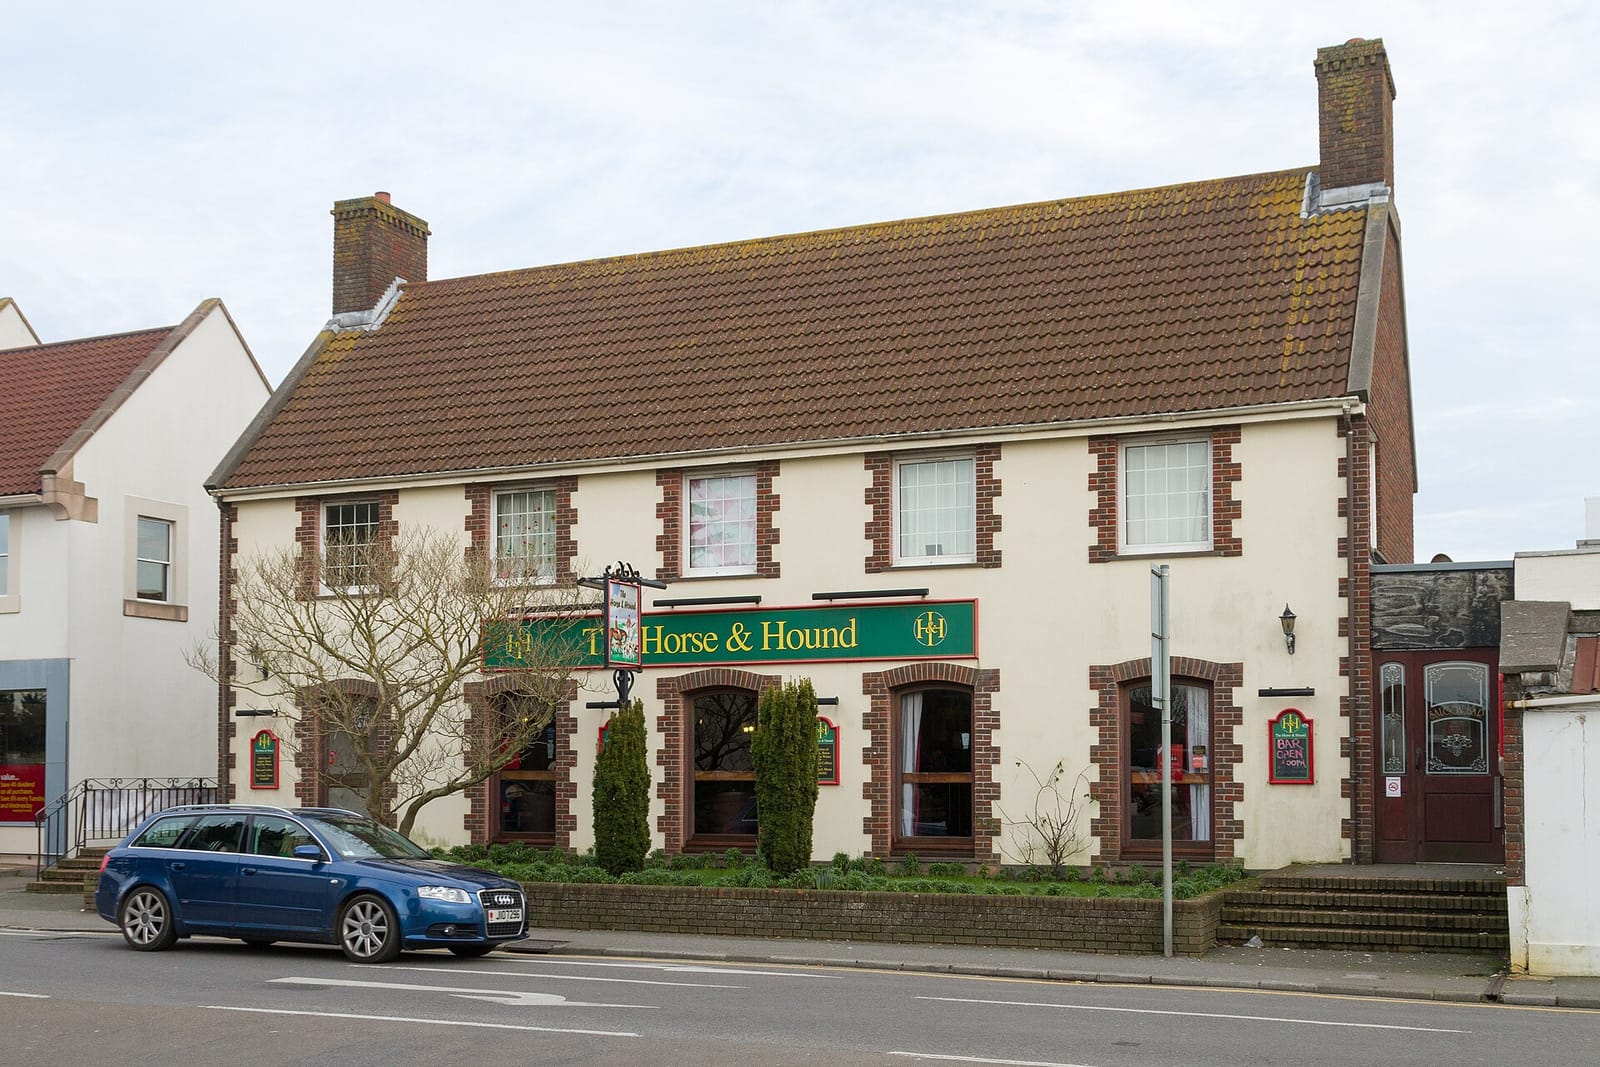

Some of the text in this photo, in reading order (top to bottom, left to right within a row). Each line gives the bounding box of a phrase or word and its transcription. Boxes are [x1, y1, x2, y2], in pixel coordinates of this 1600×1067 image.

[642, 618, 858, 654] Horse & Hound
[1276, 739, 1304, 750] BAR
[1276, 750, 1303, 760] OPEN
